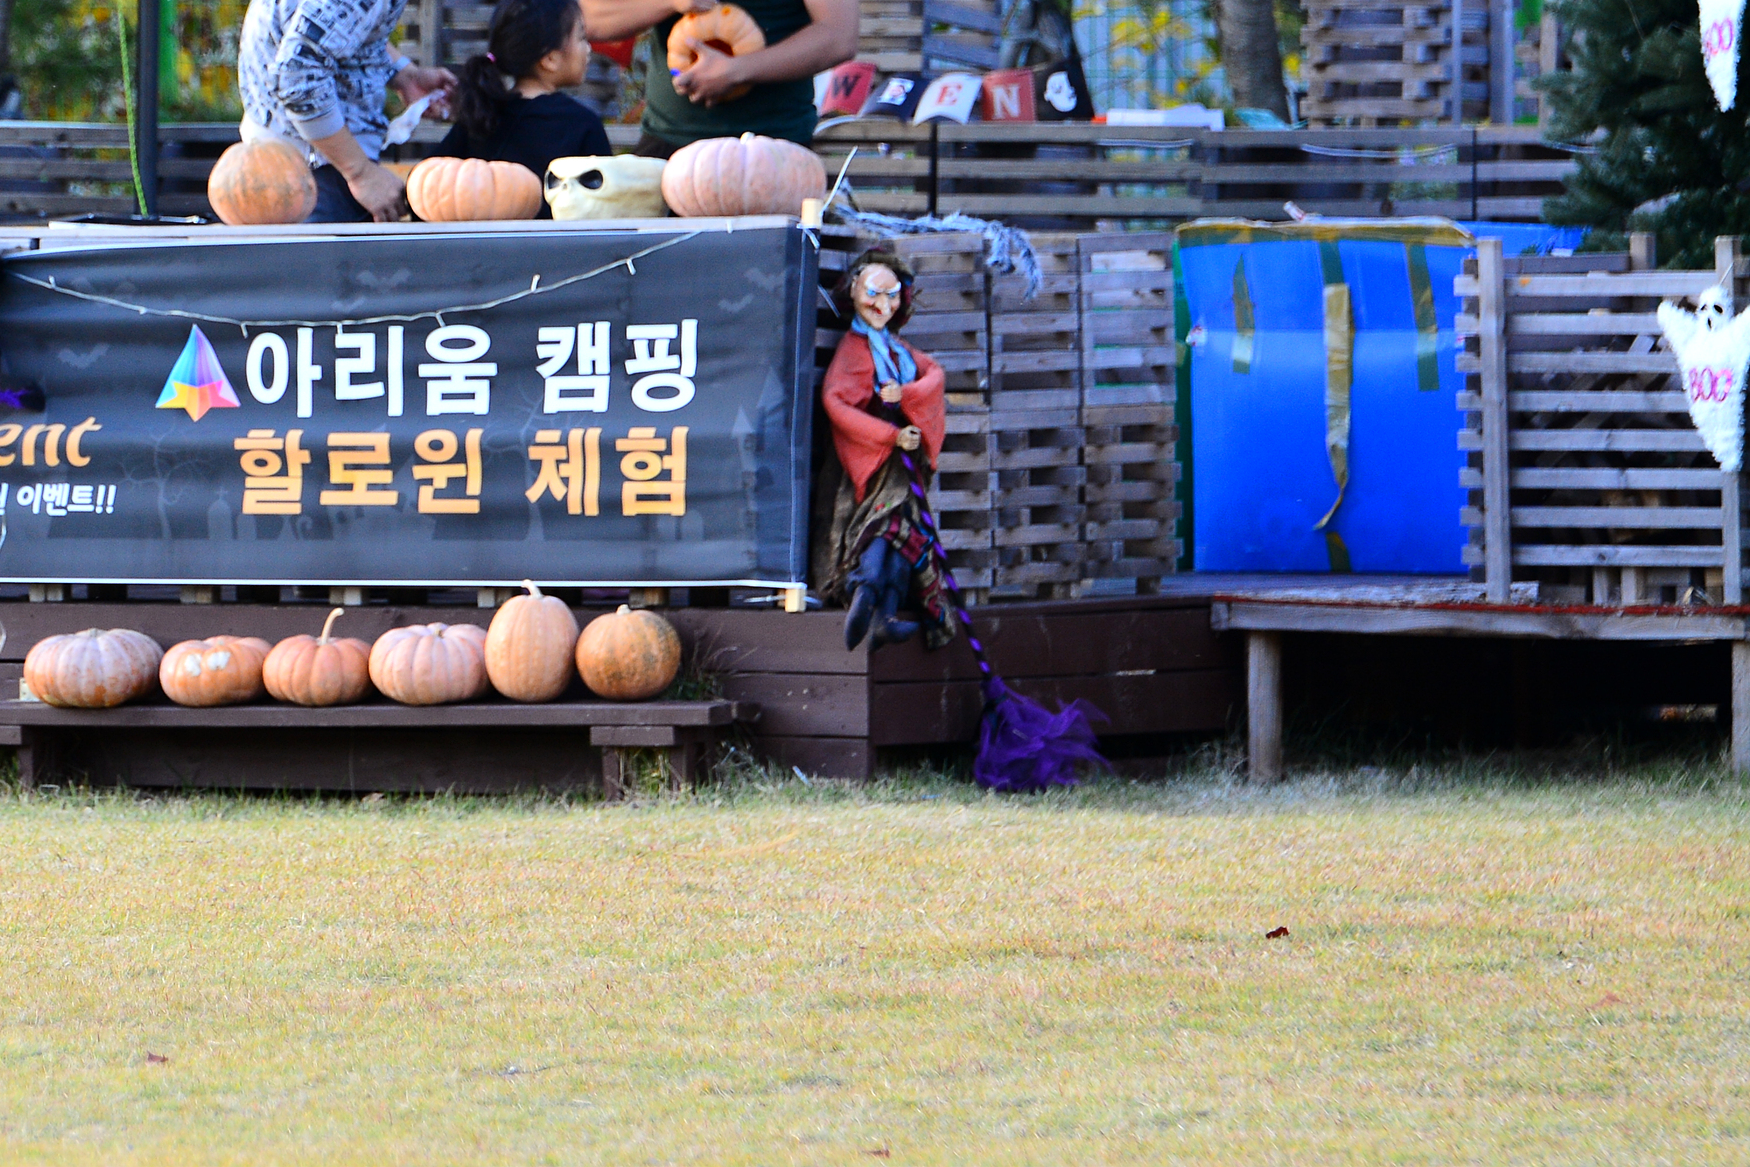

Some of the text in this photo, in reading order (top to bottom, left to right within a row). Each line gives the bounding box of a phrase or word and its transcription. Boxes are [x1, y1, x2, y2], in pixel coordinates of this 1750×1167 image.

[245, 318, 699, 418] 아리움 캠핑
[1688, 366, 1732, 403] BOO
[16, 483, 117, 517] 이벤트!!
[233, 426, 689, 517] 할로윈 체험
